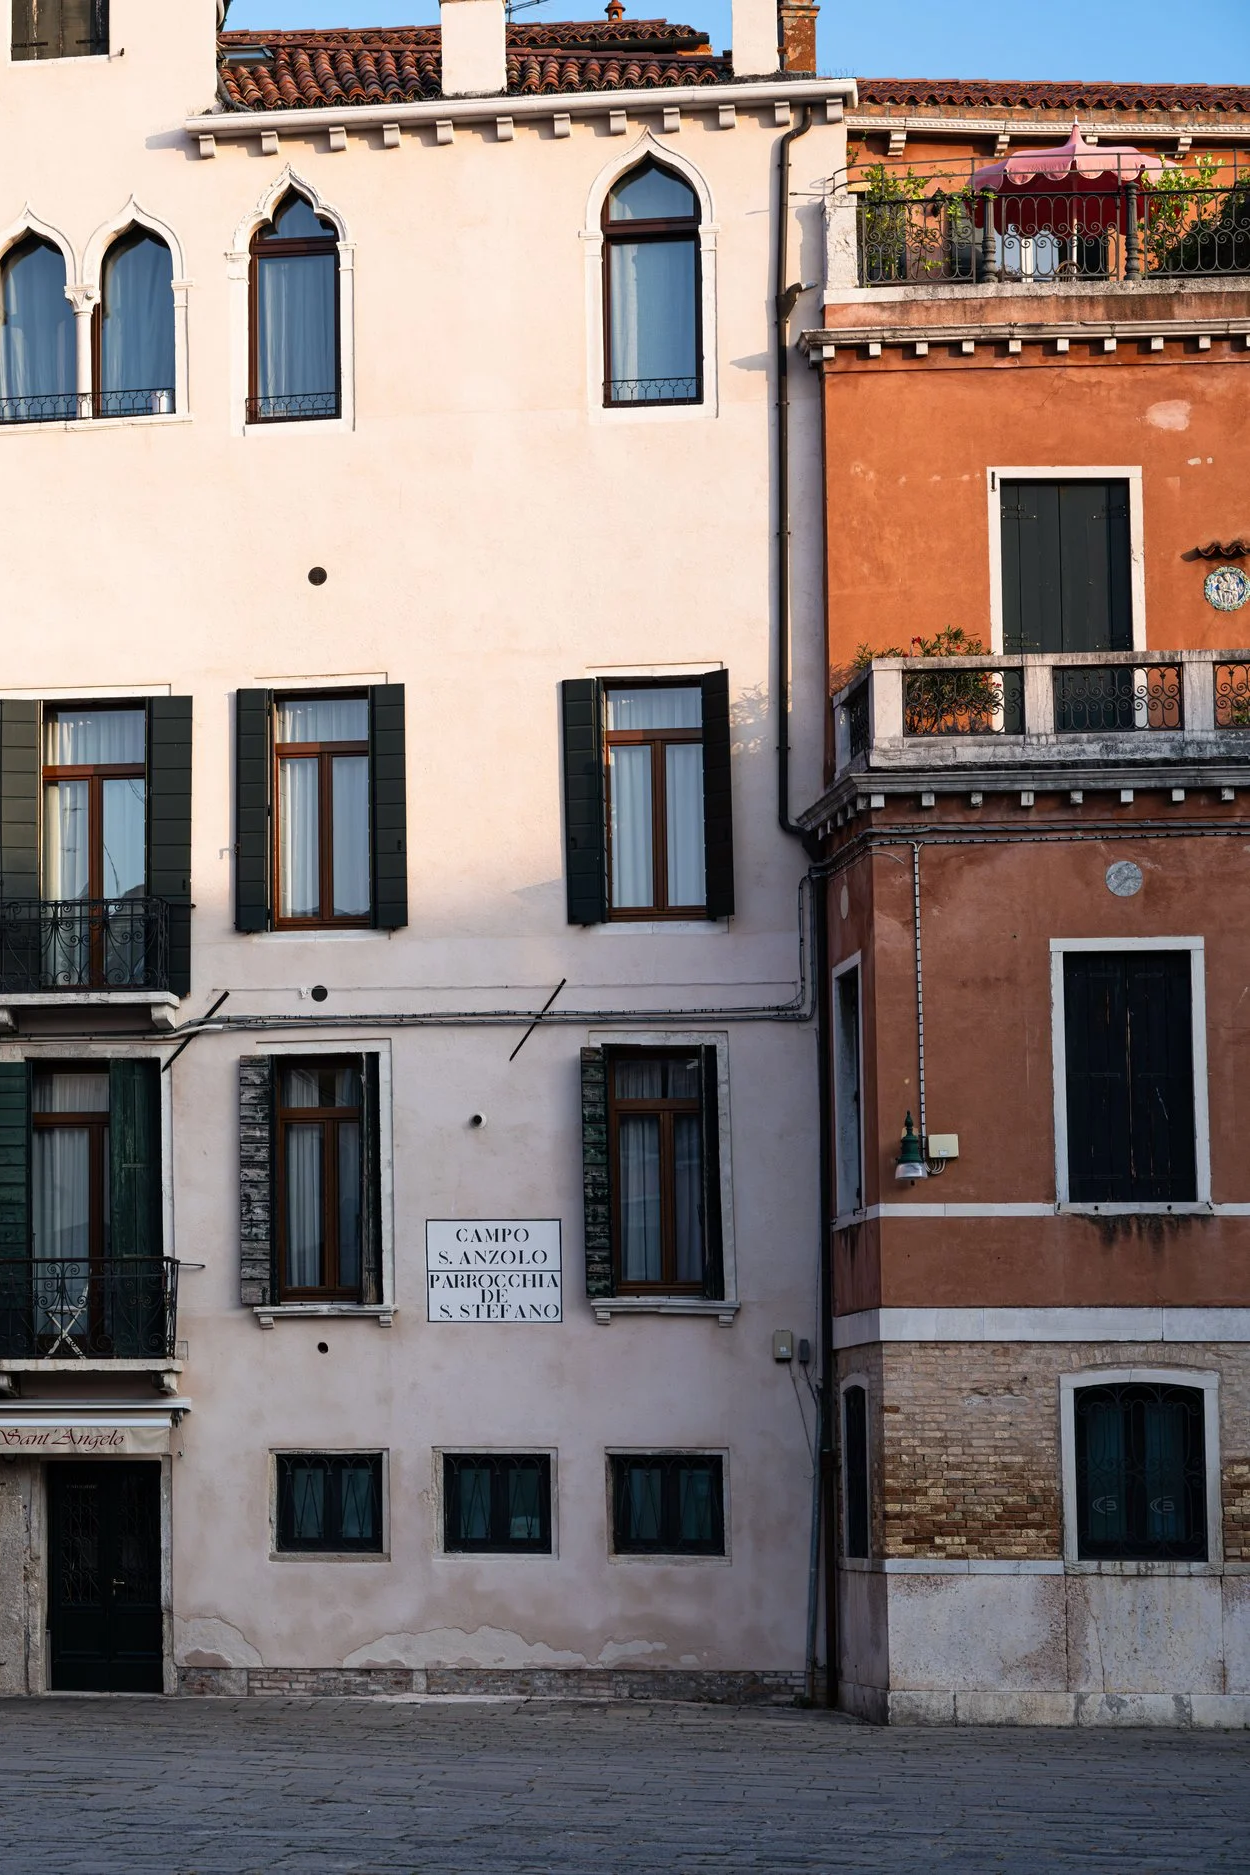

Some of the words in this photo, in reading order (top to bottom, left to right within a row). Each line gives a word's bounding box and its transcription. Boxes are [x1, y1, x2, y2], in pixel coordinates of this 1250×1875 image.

[456, 1228, 529, 1243] CAMPO
[438, 1250, 453, 1265] S.
[459, 1250, 548, 1265] ANZOLO
[430, 1273, 559, 1289] PARROCCHIA
[481, 1289, 508, 1303] DE
[439, 1304, 453, 1319] S.
[459, 1304, 560, 1319] STEFANO
